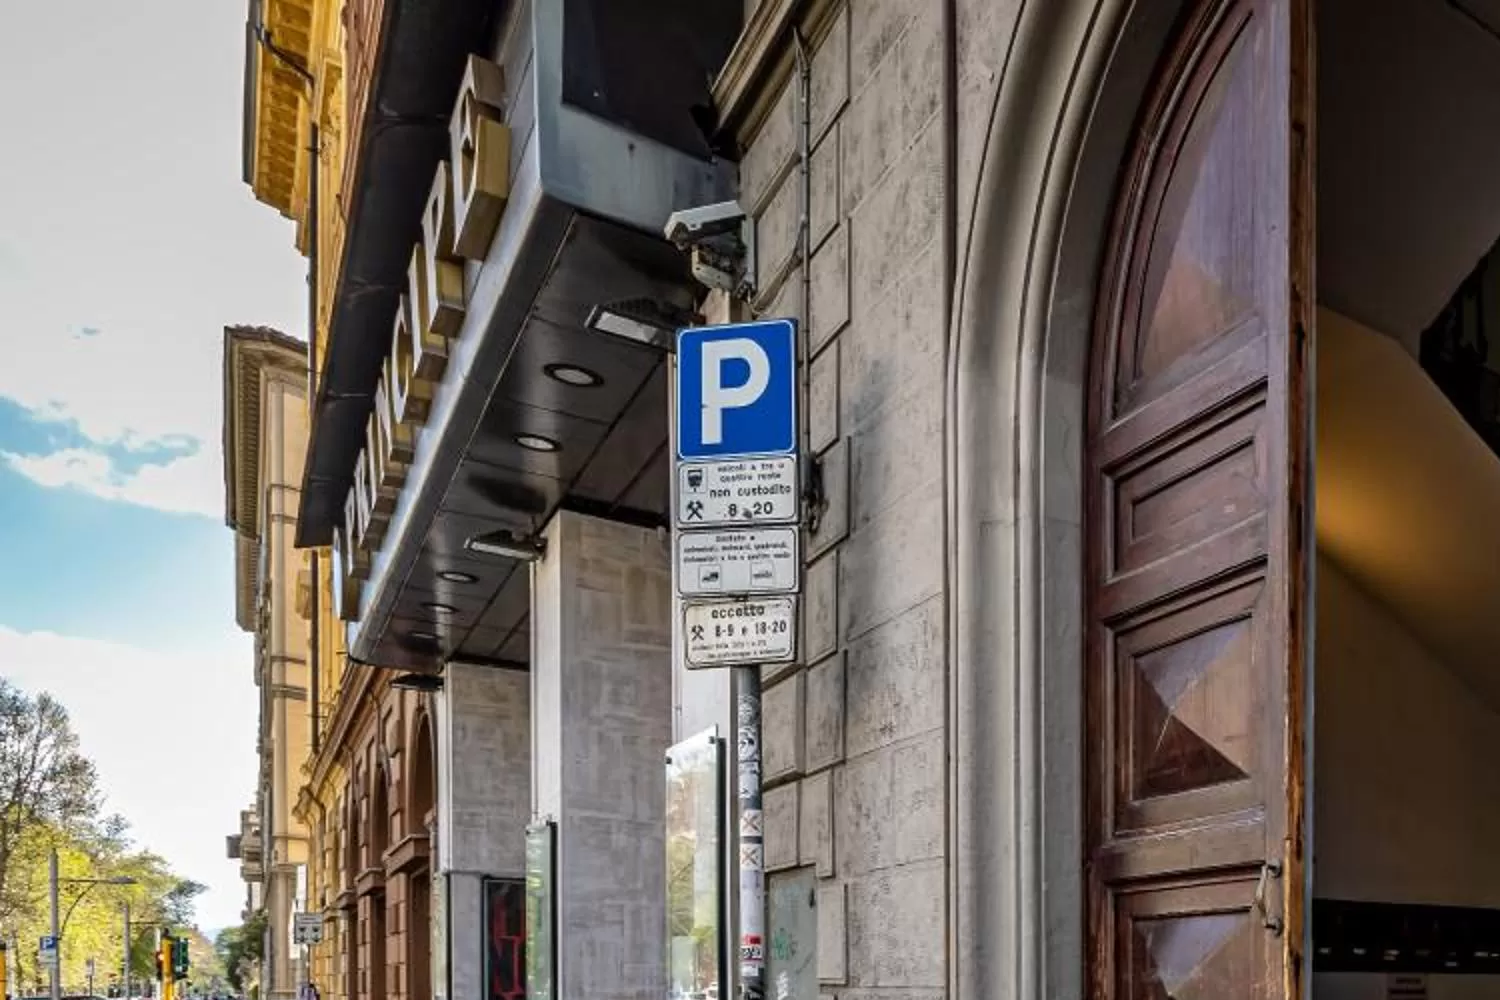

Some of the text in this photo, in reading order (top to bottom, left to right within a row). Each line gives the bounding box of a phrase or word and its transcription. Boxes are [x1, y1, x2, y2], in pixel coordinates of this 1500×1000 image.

[702, 338, 770, 445] P
[709, 484, 792, 498] non custodito
[727, 501, 774, 517] 8 20
[711, 604, 765, 619] eccetto
